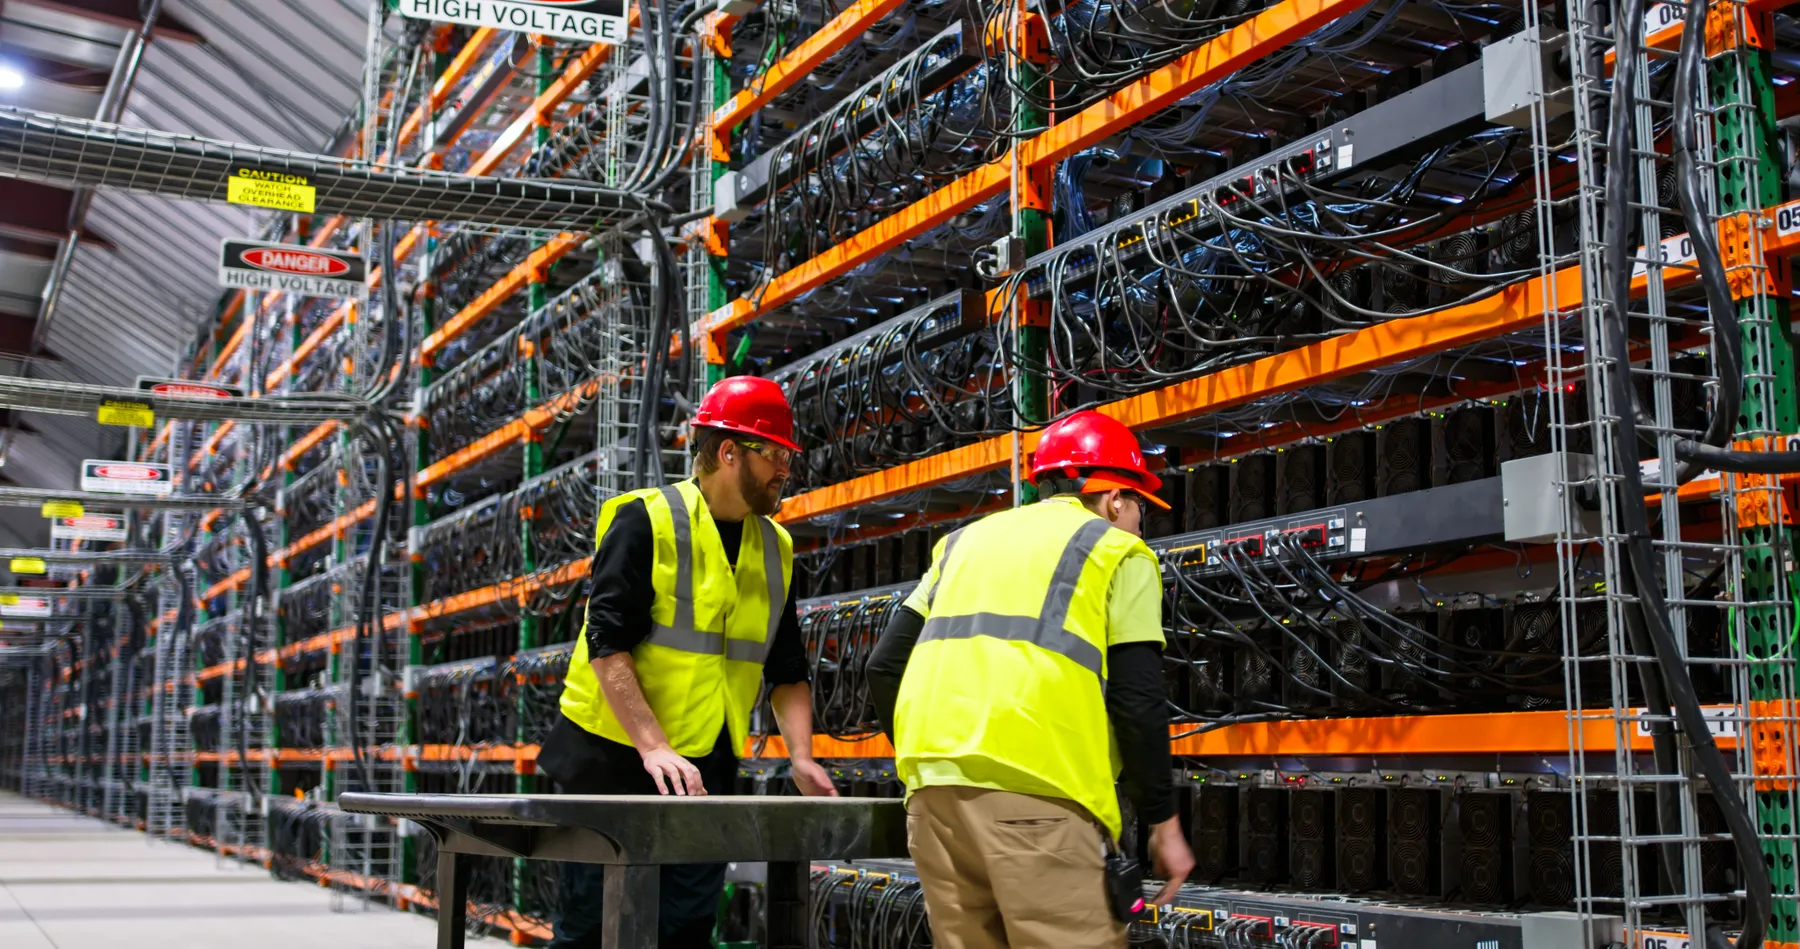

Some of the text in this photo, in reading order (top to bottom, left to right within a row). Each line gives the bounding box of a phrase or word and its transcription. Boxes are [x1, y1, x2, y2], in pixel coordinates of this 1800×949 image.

[413, 0, 615, 39] HIGH VOLTAGE
[238, 168, 308, 186] CAUTION
[242, 187, 302, 201] OVERHEAD
[254, 181, 292, 192] WATCH
[238, 194, 305, 209] CLEARANCE
[261, 251, 331, 273] DANGER
[226, 271, 361, 297] HIGH VOLTAGE
